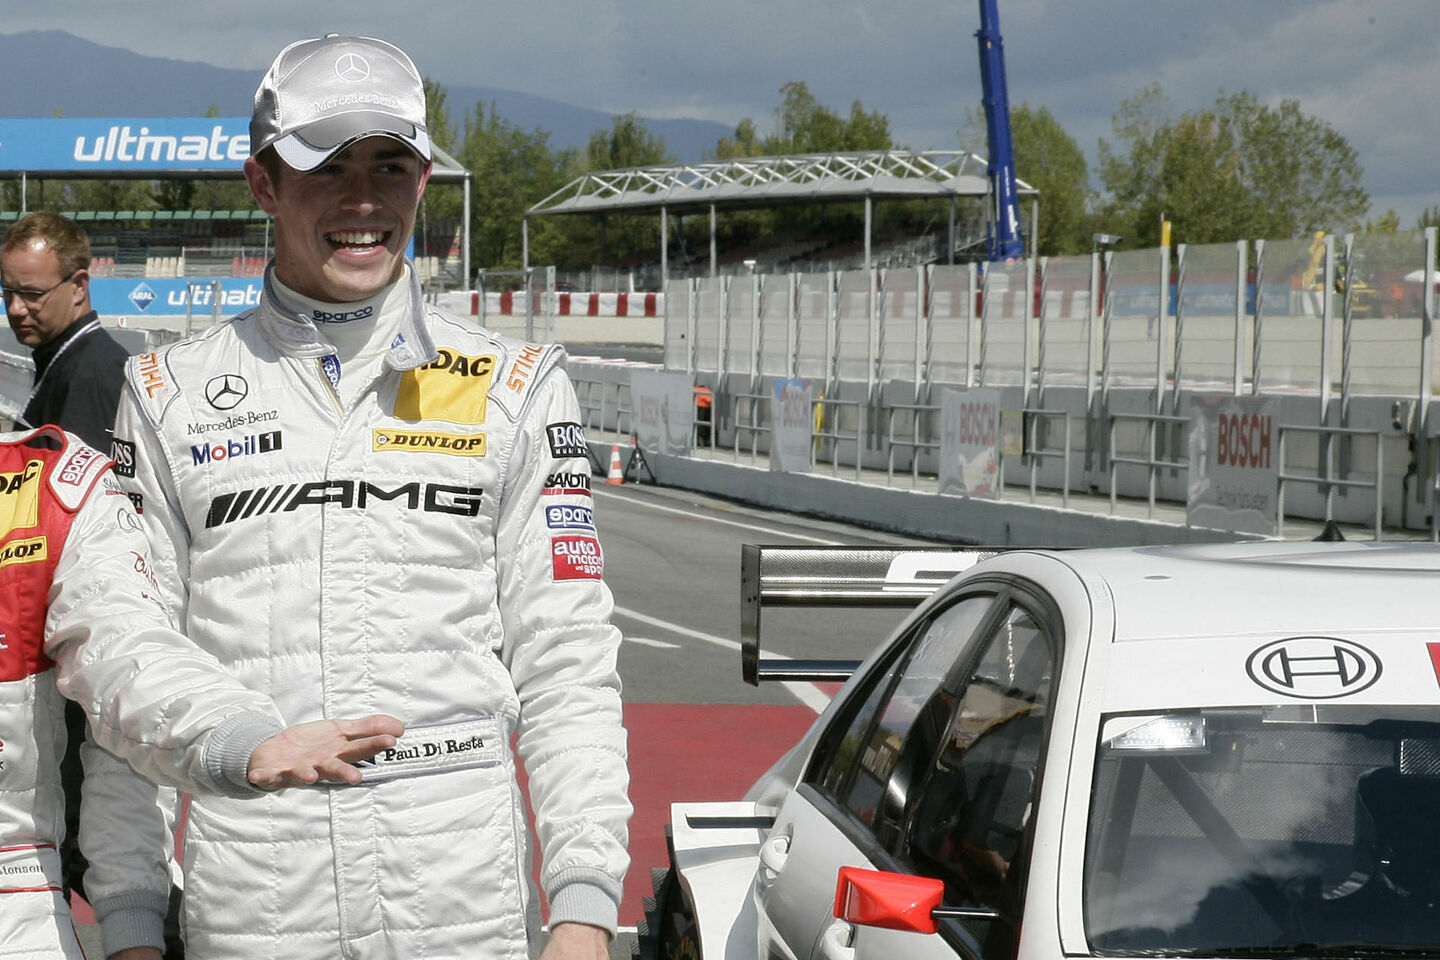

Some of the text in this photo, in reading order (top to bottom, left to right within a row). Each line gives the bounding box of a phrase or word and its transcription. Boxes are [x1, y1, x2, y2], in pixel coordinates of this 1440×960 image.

[74, 126, 250, 163] ultimate
[132, 291, 153, 300] ARAL
[312, 304, 374, 323] sparco
[136, 352, 165, 398] STIHL
[506, 344, 544, 395] STIHL
[187, 409, 280, 435] Mercedes-Benz
[960, 401, 996, 446] BOSCH
[192, 435, 256, 467] Mobil
[392, 433, 483, 452] DUNLOP
[1218, 413, 1271, 469] BOSCH
[61, 446, 98, 484] sparco
[282, 480, 483, 516] AMG
[554, 541, 596, 555] auto
[383, 735, 485, 763] Paul Di Resta
